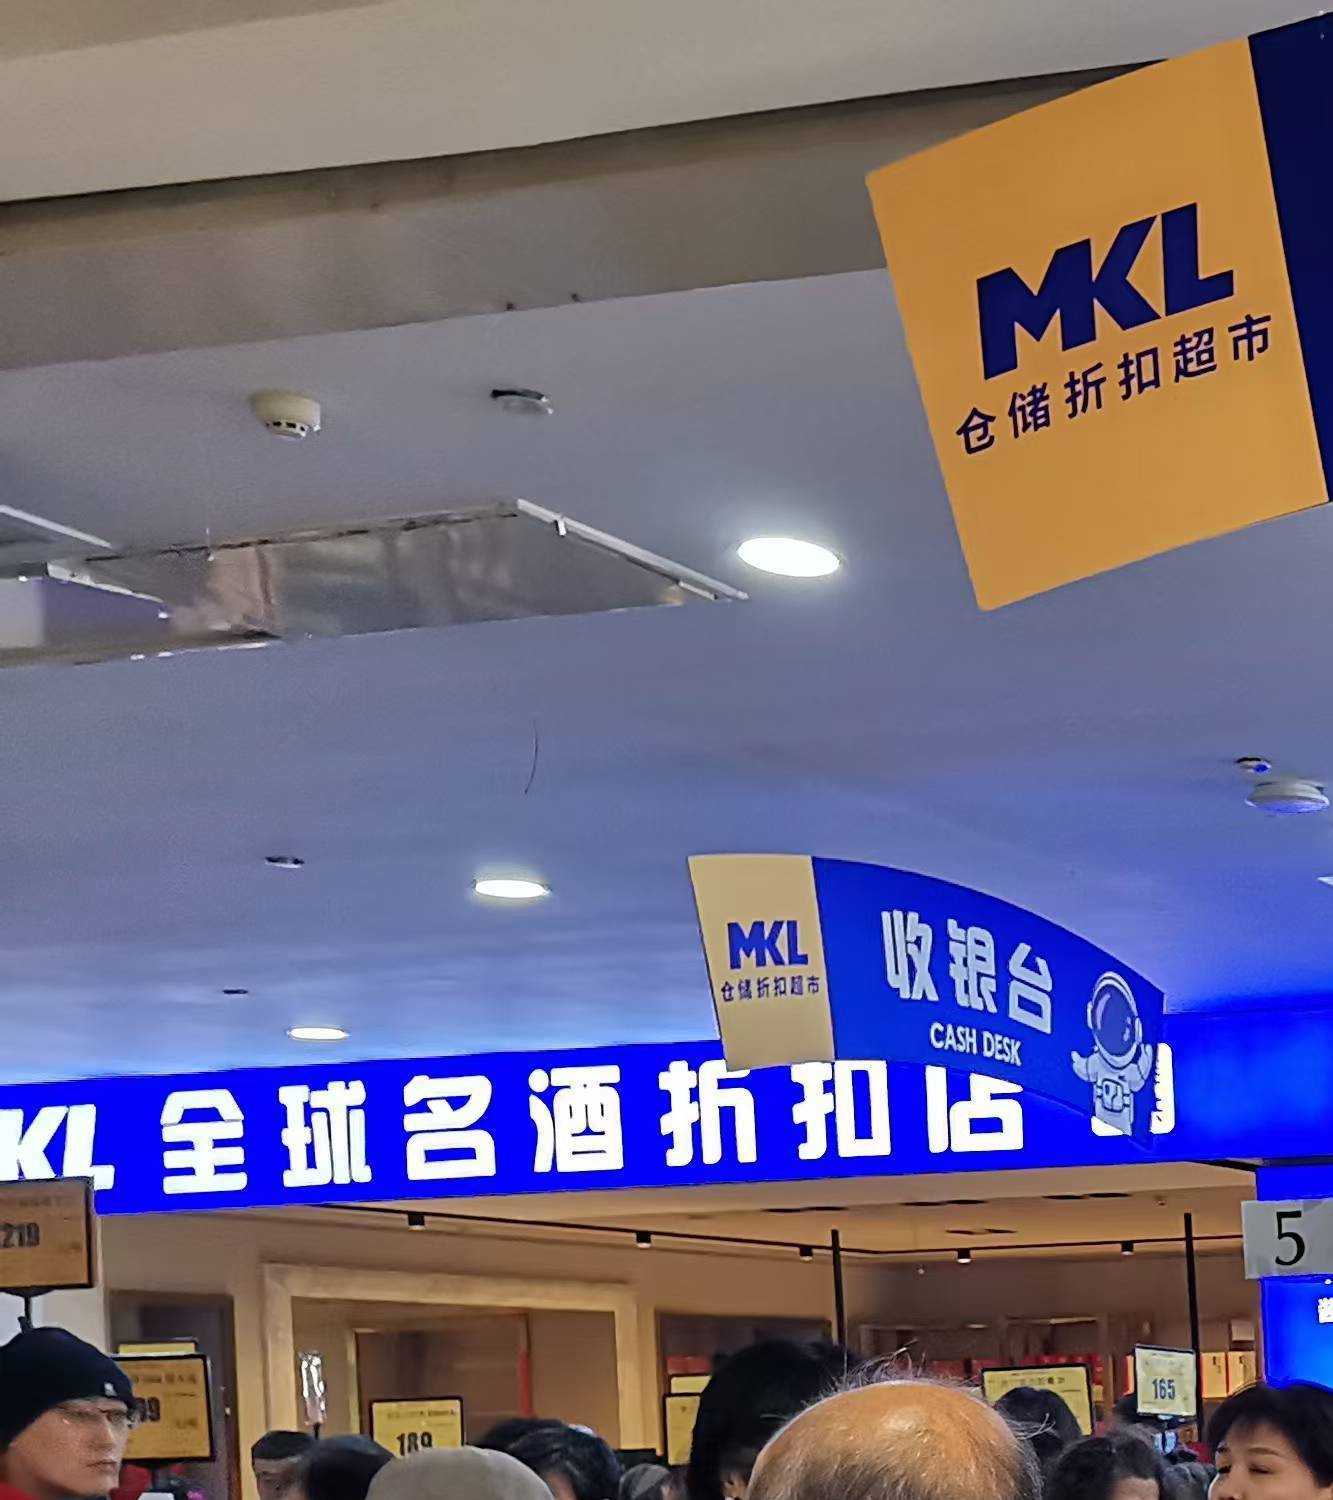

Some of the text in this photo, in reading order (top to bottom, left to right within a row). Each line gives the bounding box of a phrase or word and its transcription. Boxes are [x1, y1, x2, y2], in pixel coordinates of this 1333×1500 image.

[976, 202, 1235, 381] MKL
[956, 314, 1272, 455] 仓储折扣超市
[727, 919, 809, 970] MKL
[880, 908, 1053, 1035] 收银台
[720, 974, 821, 1002] 仓储折扣超市
[929, 1021, 1021, 1067] CASH DESK
[0, 1104, 116, 1191] KL
[1273, 1210, 1306, 1266] 5
[1152, 1378, 1176, 1401] 165
